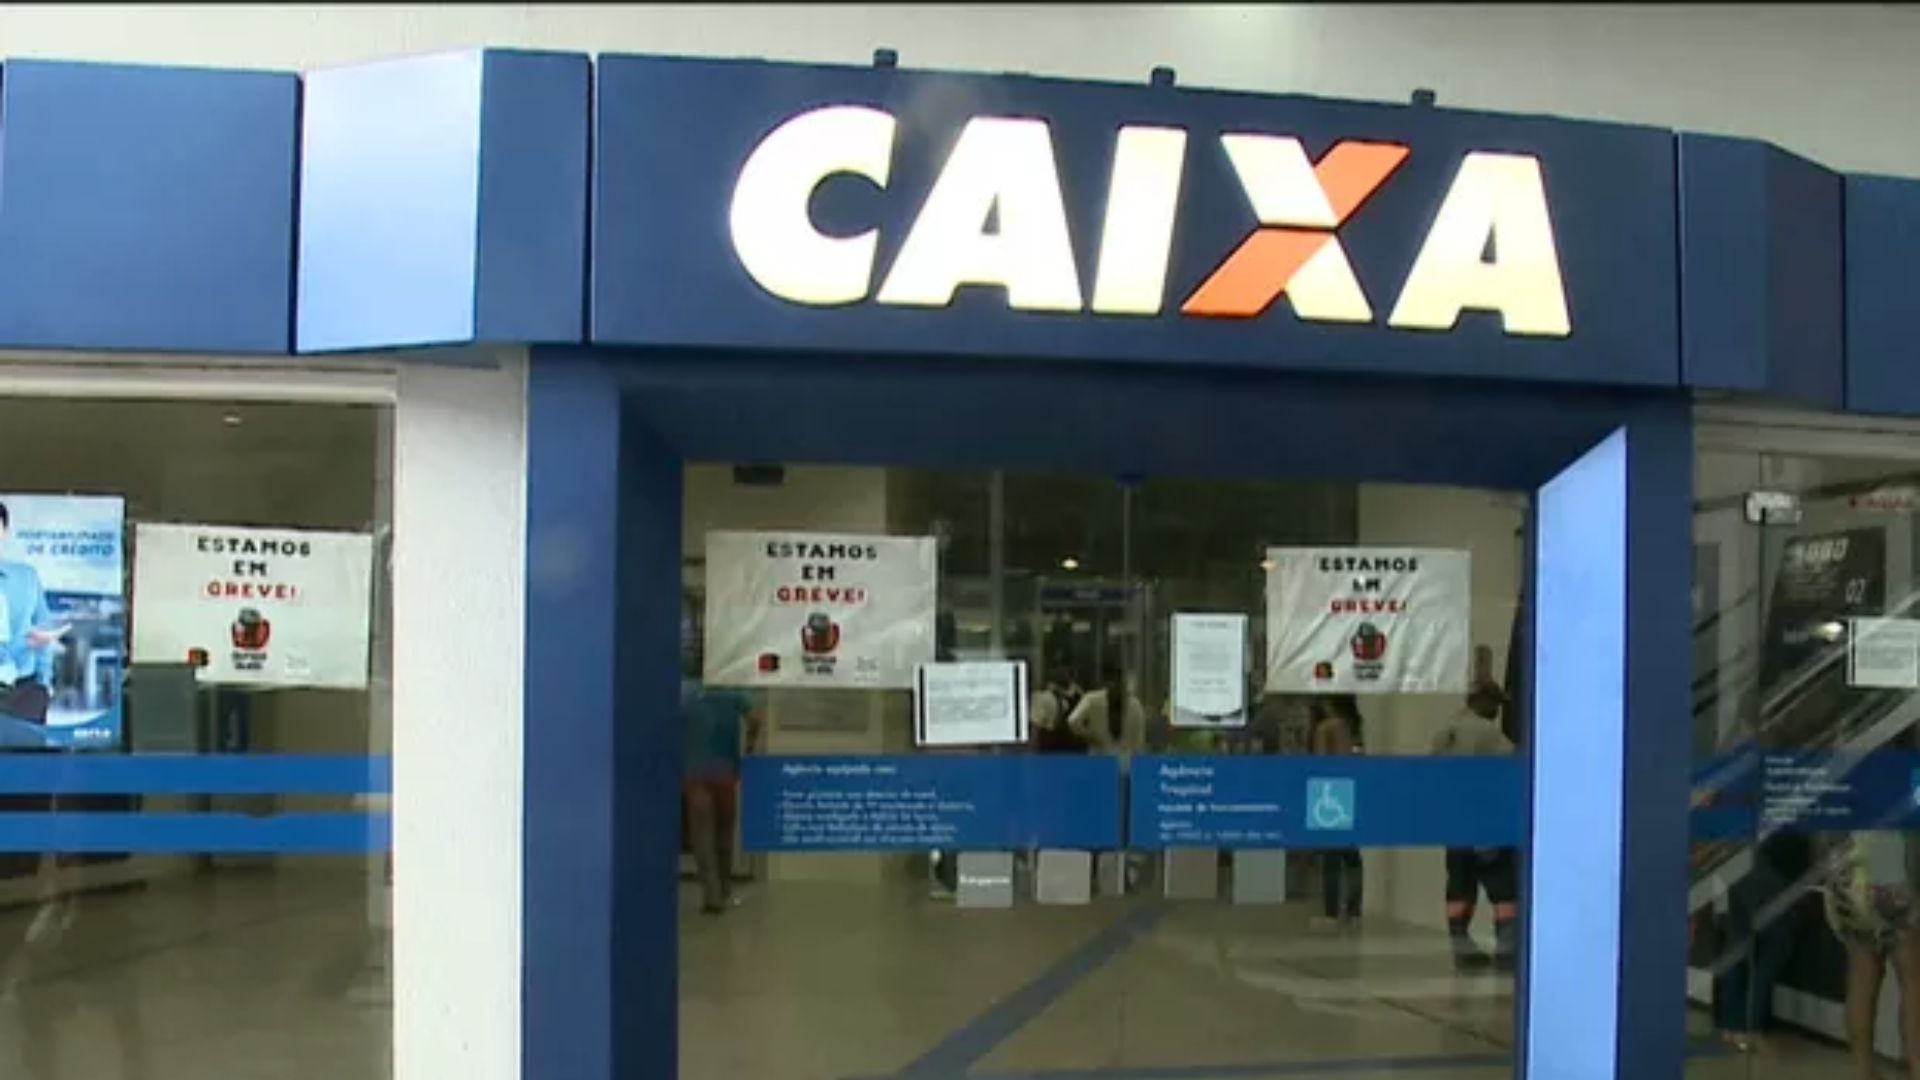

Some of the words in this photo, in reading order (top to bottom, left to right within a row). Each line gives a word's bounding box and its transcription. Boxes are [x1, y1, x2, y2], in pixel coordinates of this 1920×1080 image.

[729, 105, 1571, 335] CAIXA
[197, 536, 311, 556] ESTAMOS
[766, 543, 877, 560] ESTAMOS
[233, 560, 267, 576] EM
[1319, 557, 1418, 573] ESTAMOS
[801, 566, 835, 581] EM
[207, 582, 297, 599] GREVE!
[777, 588, 866, 604] GREVE!
[1331, 600, 1407, 614] GREVE!
